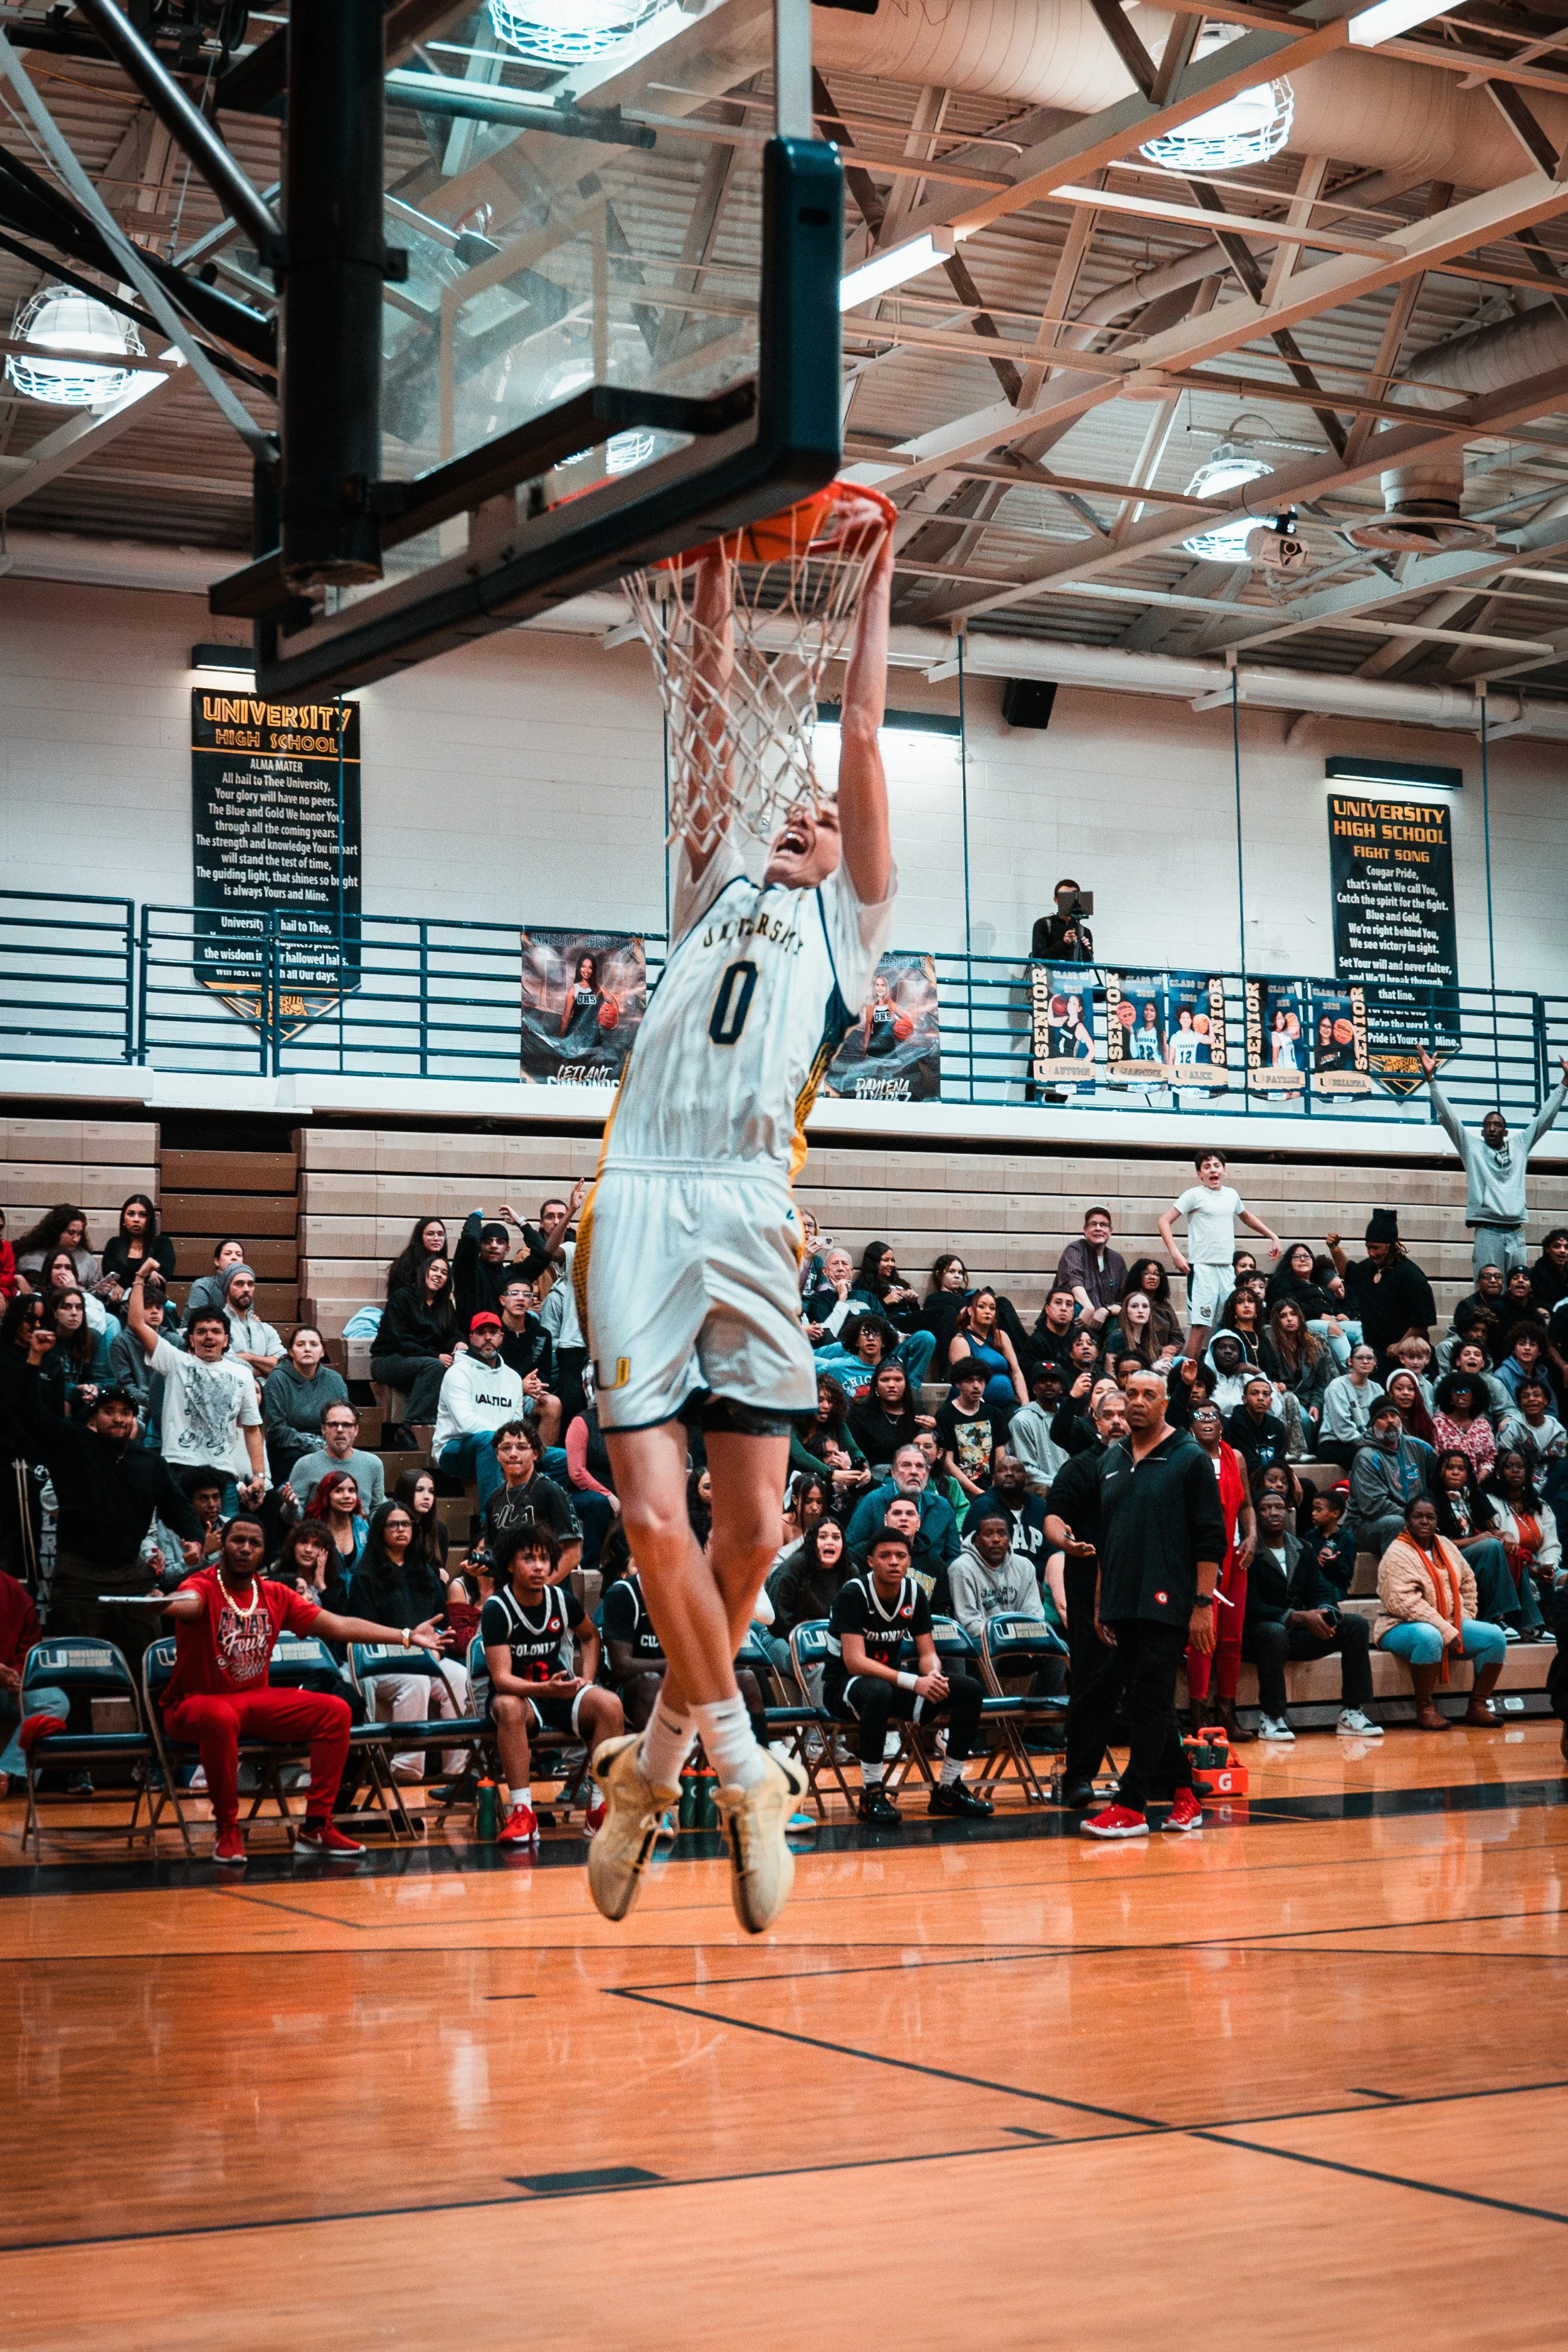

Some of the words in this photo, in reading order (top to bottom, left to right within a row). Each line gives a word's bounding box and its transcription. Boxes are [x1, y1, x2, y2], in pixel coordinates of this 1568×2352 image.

[203, 697, 352, 731] UNIVERSITY
[216, 729, 260, 748] HIGH
[270, 733, 338, 753] SCHOOL
[250, 758, 274, 771] ALMA
[275, 760, 303, 773] MATER
[222, 772, 233, 783] All
[235, 773, 252, 785] hail
[253, 775, 263, 786] to
[263, 775, 285, 787] Thee
[287, 776, 331, 793] University,
[215, 787, 235, 799] Your
[236, 789, 258, 804] glory
[260, 791, 276, 802] will
[278, 792, 297, 804] have
[299, 796, 309, 805] no
[311, 797, 337, 808] peers.
[208, 803, 224, 815] The
[226, 804, 245, 816] Blue
[246, 806, 263, 817] and
[265, 807, 284, 818] Gold
[285, 808, 298, 820] We
[300, 809, 326, 822] honor
[1333, 800, 1444, 824] UNIVERSITY
[215, 820, 250, 835] through
[252, 822, 263, 833] all
[265, 823, 279, 834] the
[281, 825, 310, 839] coming
[312, 829, 337, 840] years.
[1334, 820, 1375, 838] HIGH
[1382, 825, 1446, 844] SCHOOL
[196, 834, 211, 846] The
[212, 837, 248, 850] strength
[250, 838, 266, 849] and
[267, 839, 311, 855] knowledge
[312, 842, 327, 854] You
[1353, 845, 1390, 859] FIGHT
[1395, 849, 1429, 862] SONG
[221, 852, 238, 863] will
[239, 854, 263, 865] stand
[265, 855, 280, 866] the
[281, 857, 297, 867] test
[299, 857, 308, 868] of
[309, 858, 332, 871] time,
[196, 866, 211, 878] The
[212, 868, 246, 882] guiding
[248, 869, 271, 884] light,
[272, 871, 290, 883] that
[292, 872, 318, 885] shines
[319, 877, 329, 886] so
[1366, 865, 1394, 879] Cougar
[1396, 867, 1419, 881] Pride,
[225, 884, 231, 895] is
[233, 884, 263, 899] always
[263, 886, 286, 899] Yours
[287, 889, 304, 900] and
[305, 889, 329, 901] Mine.
[1347, 878, 1370, 890] that's
[1371, 881, 1392, 892] what
[1393, 882, 1406, 893] We
[1407, 884, 1421, 894] call
[1421, 884, 1438, 897] You,
[1337, 893, 1360, 904] Catch
[1360, 894, 1375, 905] the
[1376, 896, 1398, 908] spirit
[1399, 897, 1411, 908] for
[1412, 898, 1425, 909] the
[1426, 899, 1448, 913] fight.
[1366, 909, 1384, 921] Blue
[1385, 911, 1401, 921] and
[1402, 912, 1422, 924] Gold,
[281, 919, 297, 931] hail
[298, 921, 307, 932] to
[309, 921, 332, 935] Thee,
[1348, 923, 1372, 935] We're
[1372, 924, 1393, 938] right
[1394, 926, 1422, 938] behind
[1422, 928, 1439, 941] You,
[1349, 937, 1363, 948] We
[1364, 941, 1378, 950] see
[1379, 940, 1407, 953] victory
[1407, 941, 1416, 952] in
[1416, 942, 1439, 955] sight.
[204, 947, 219, 959] the
[220, 948, 254, 960] wisdom
[286, 951, 324, 965] hallowed
[326, 955, 349, 966] hals.
[1339, 956, 1353, 968] Set
[1353, 957, 1372, 968] Your
[1372, 958, 1387, 970] will
[1388, 960, 1403, 970] and
[1404, 963, 1426, 972] never
[1426, 962, 1452, 975] falter,
[287, 970, 297, 980] all
[299, 970, 315, 980] Our
[315, 971, 338, 983] days.
[577, 995, 596, 1005] UHS
[708, 960, 760, 1047] 0
[1378, 988, 1396, 1000] that
[1397, 990, 1415, 1001] line.
[874, 1012, 891, 1022] UHS
[1032, 968, 1049, 1057] SENIOR
[1106, 973, 1123, 1061] SENIOR
[1209, 978, 1225, 1064] SENIOR
[1245, 983, 1261, 1067] SENIOR
[1350, 987, 1368, 1070] SENIOR
[1424, 1021, 1445, 1030] bst.
[1368, 1032, 1389, 1044] Pride
[1389, 1034, 1396, 1044] is
[1396, 1034, 1418, 1046] Yours
[1419, 1037, 1430, 1047] an
[1435, 1038, 1459, 1048] Mine.
[1012, 1524, 1043, 1554] AP
[1219, 1773, 1232, 1791] G
